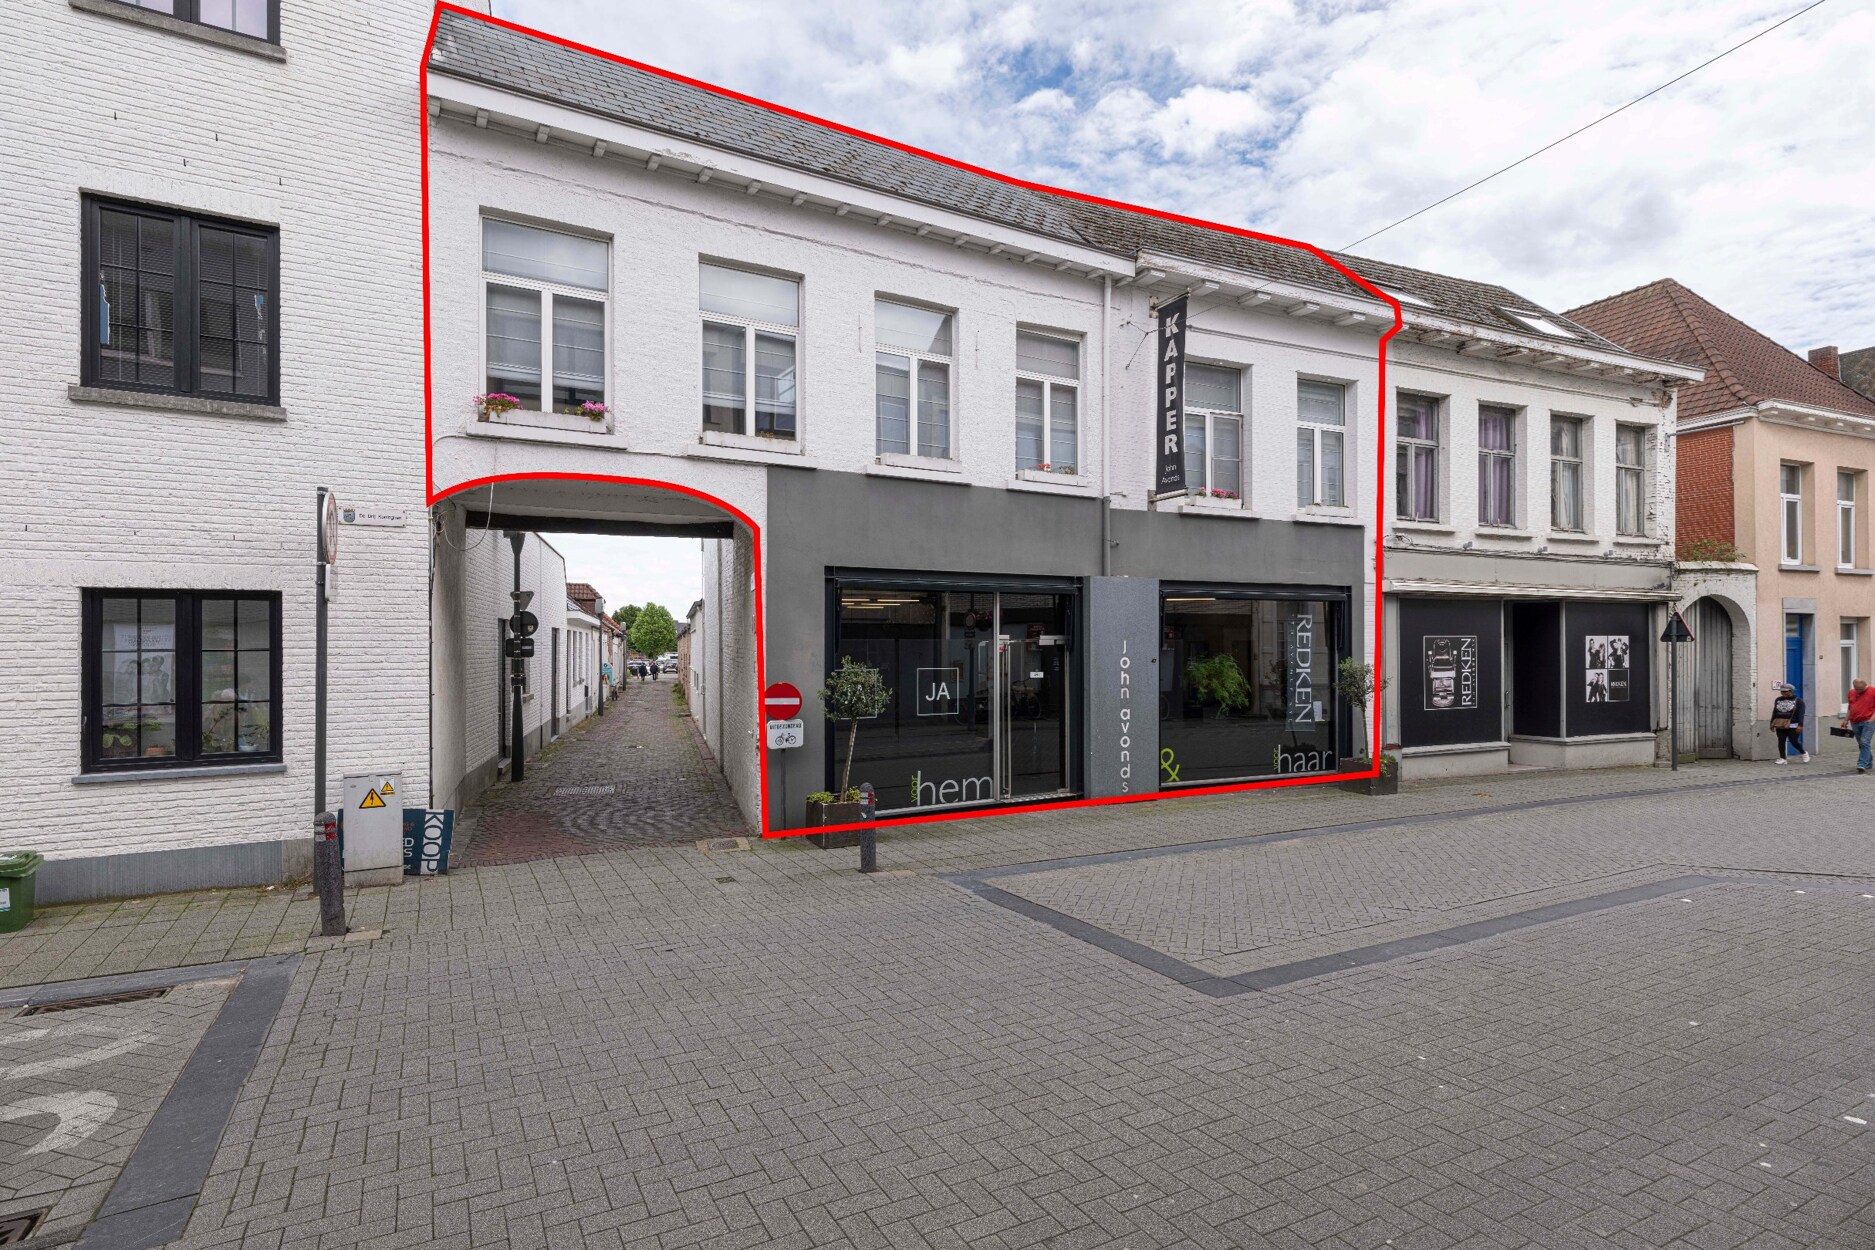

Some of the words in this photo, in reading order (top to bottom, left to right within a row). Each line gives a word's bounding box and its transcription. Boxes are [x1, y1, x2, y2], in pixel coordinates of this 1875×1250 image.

[1164, 313, 1180, 455] KAPPER
[925, 682, 950, 701] JA
[1295, 614, 1312, 723] REDKEN
[1461, 638, 1472, 706] REDKEN
[1120, 708, 1130, 793] avonds
[1278, 744, 1333, 773] haar
[917, 770, 993, 806] hem
[420, 811, 445, 873] KOOP
